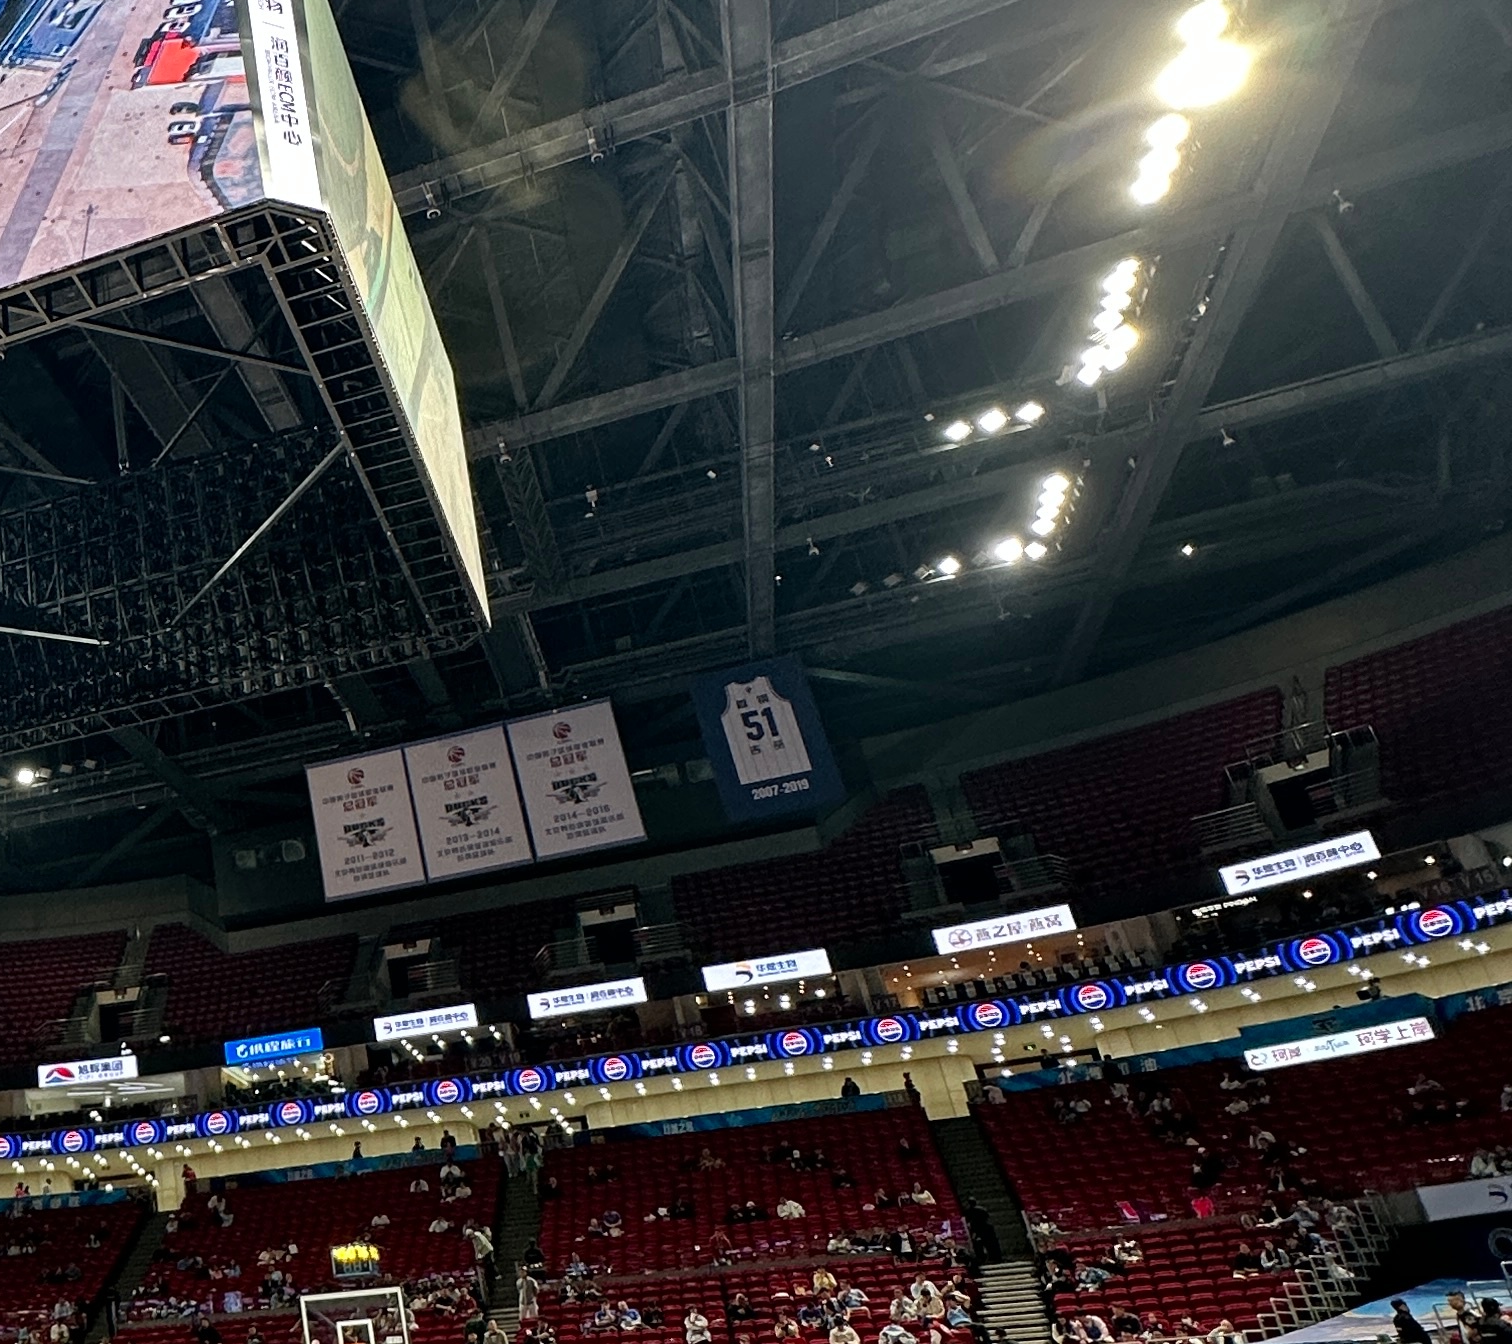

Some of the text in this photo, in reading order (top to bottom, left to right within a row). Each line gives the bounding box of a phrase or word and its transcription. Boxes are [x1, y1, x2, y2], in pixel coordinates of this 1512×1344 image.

[740, 706, 779, 741] 51
[1349, 928, 1401, 949] PEPSI
[1234, 955, 1282, 974] PEPSI
[1123, 978, 1169, 996] PEPSI
[1018, 998, 1062, 1016] PEPSI
[918, 1016, 960, 1031] PEPSI
[822, 1030, 862, 1045] PEPSI
[730, 1043, 768, 1058] PEPSI
